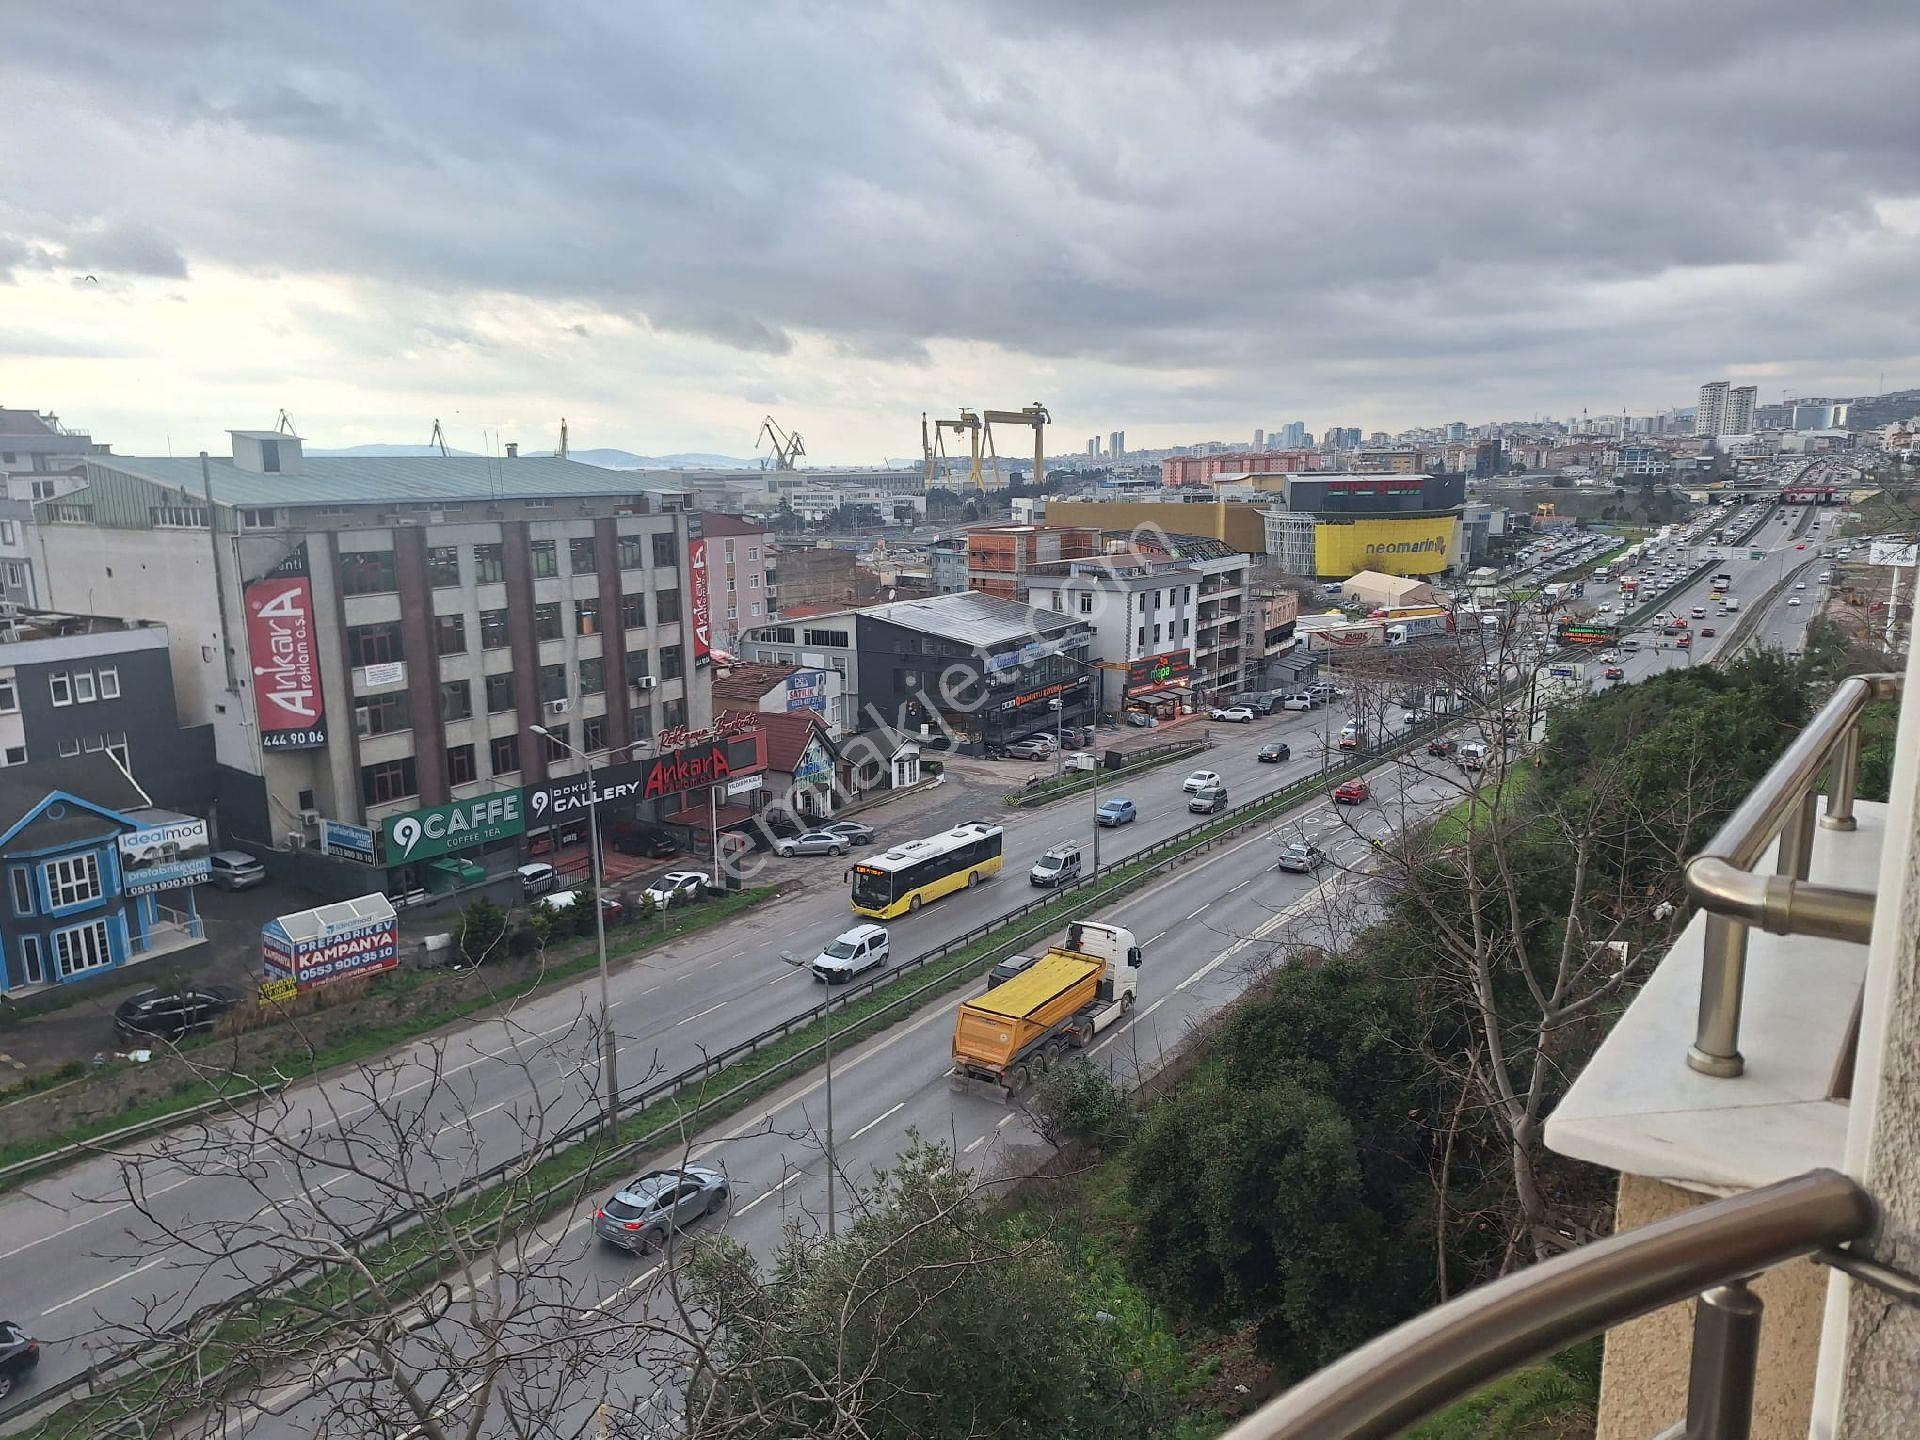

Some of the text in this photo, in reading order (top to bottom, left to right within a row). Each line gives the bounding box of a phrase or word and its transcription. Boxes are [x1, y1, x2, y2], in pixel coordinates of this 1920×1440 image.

[1366, 537, 1434, 554] neomarin
[296, 641, 312, 688] reklam
[790, 688, 814, 699] SATILIK
[263, 730, 324, 746] 444 90 06
[553, 780, 597, 797] DOKUZ
[554, 781, 640, 812] GALLERY
[532, 791, 549, 818] 9
[447, 827, 501, 848] COFFEE TEA
[128, 859, 206, 883] prefabrikevim
[131, 883, 158, 895] 0553
[195, 872, 208, 882] 10
[375, 920, 392, 932] EV
[299, 932, 393, 969] KAMPANYA
[300, 963, 333, 981] 0553
[335, 955, 360, 970] 900
[362, 951, 377, 963] 35
[379, 946, 393, 958] 10
